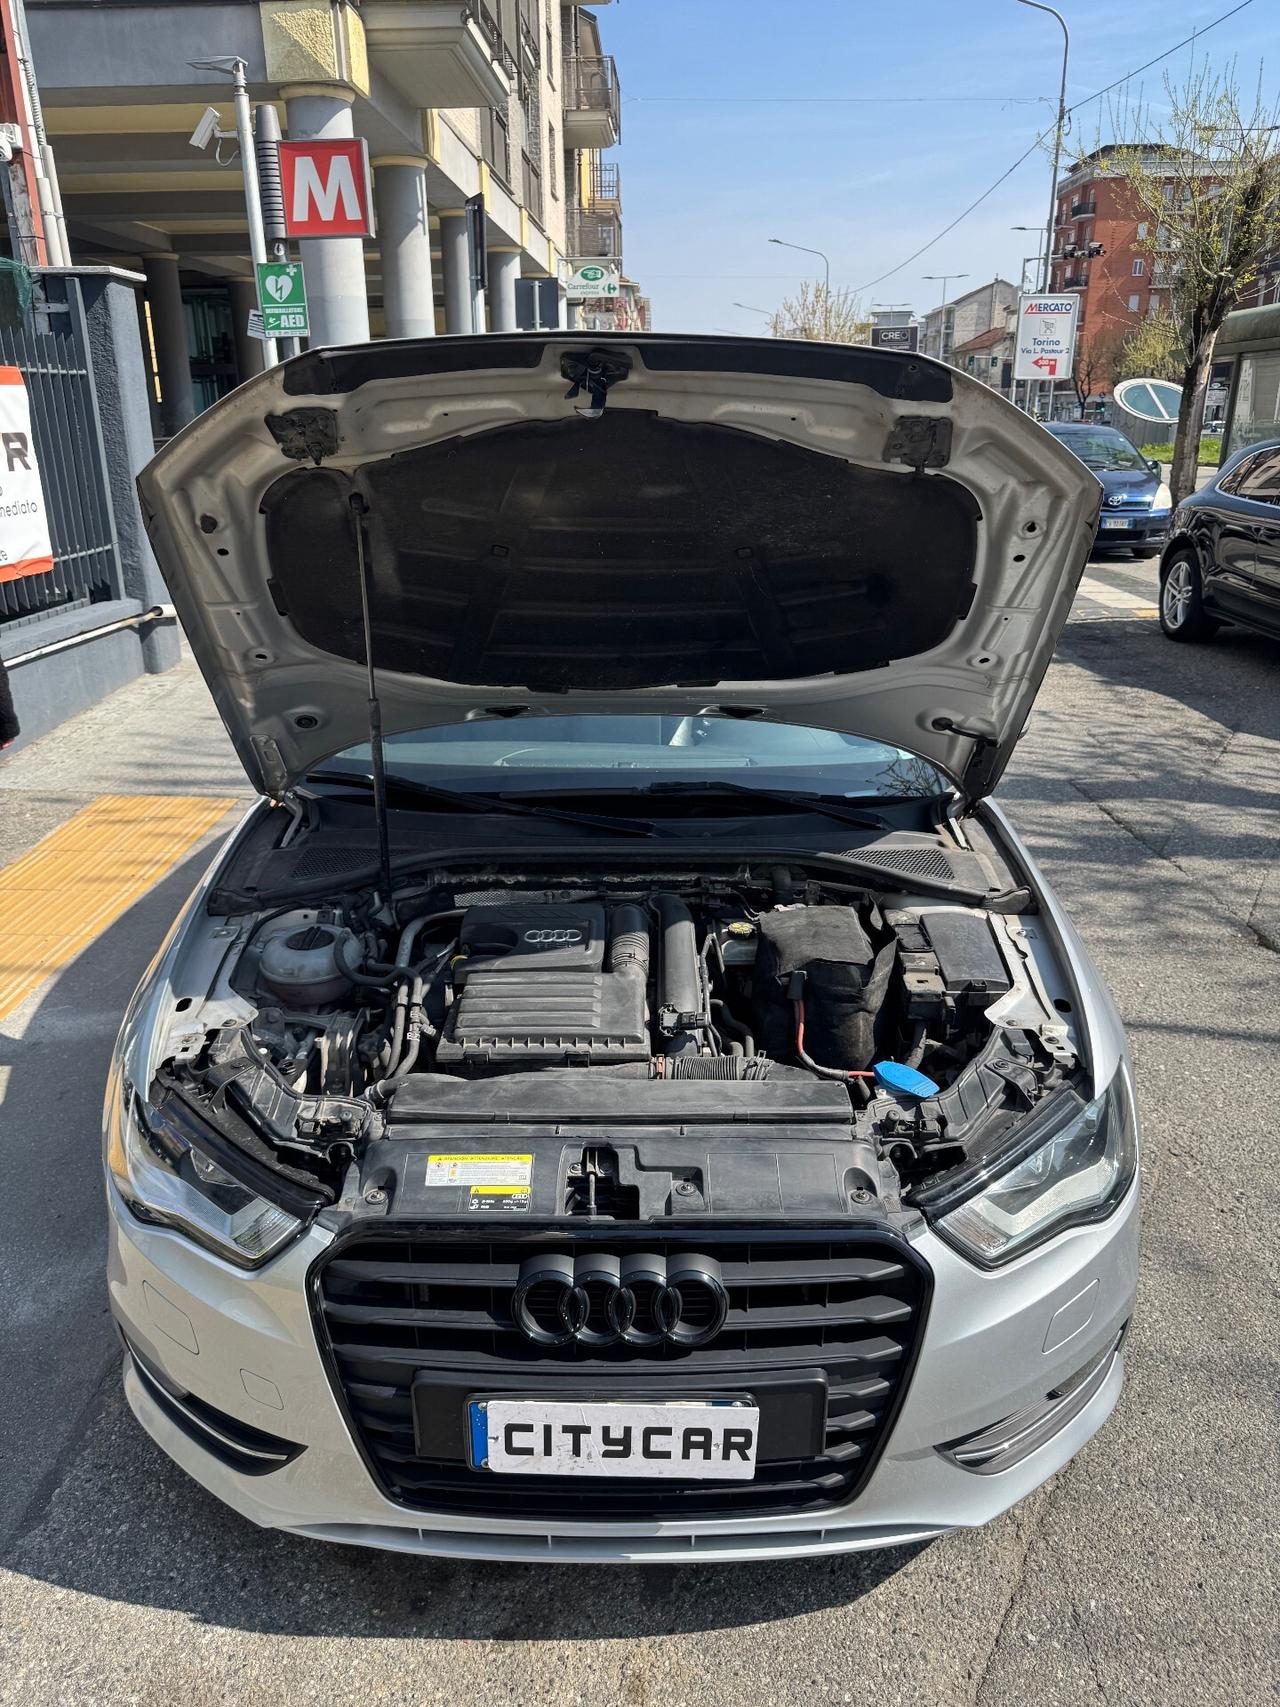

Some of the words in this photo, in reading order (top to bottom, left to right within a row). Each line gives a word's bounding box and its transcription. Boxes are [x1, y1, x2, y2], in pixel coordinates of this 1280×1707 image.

[292, 155, 362, 222] M
[567, 282, 600, 290] Carrefour
[1024, 303, 1072, 314] MERCATO
[280, 314, 305, 328] AED
[1032, 337, 1061, 346] Torino
[504, 1423, 754, 1462] CITYCAR
